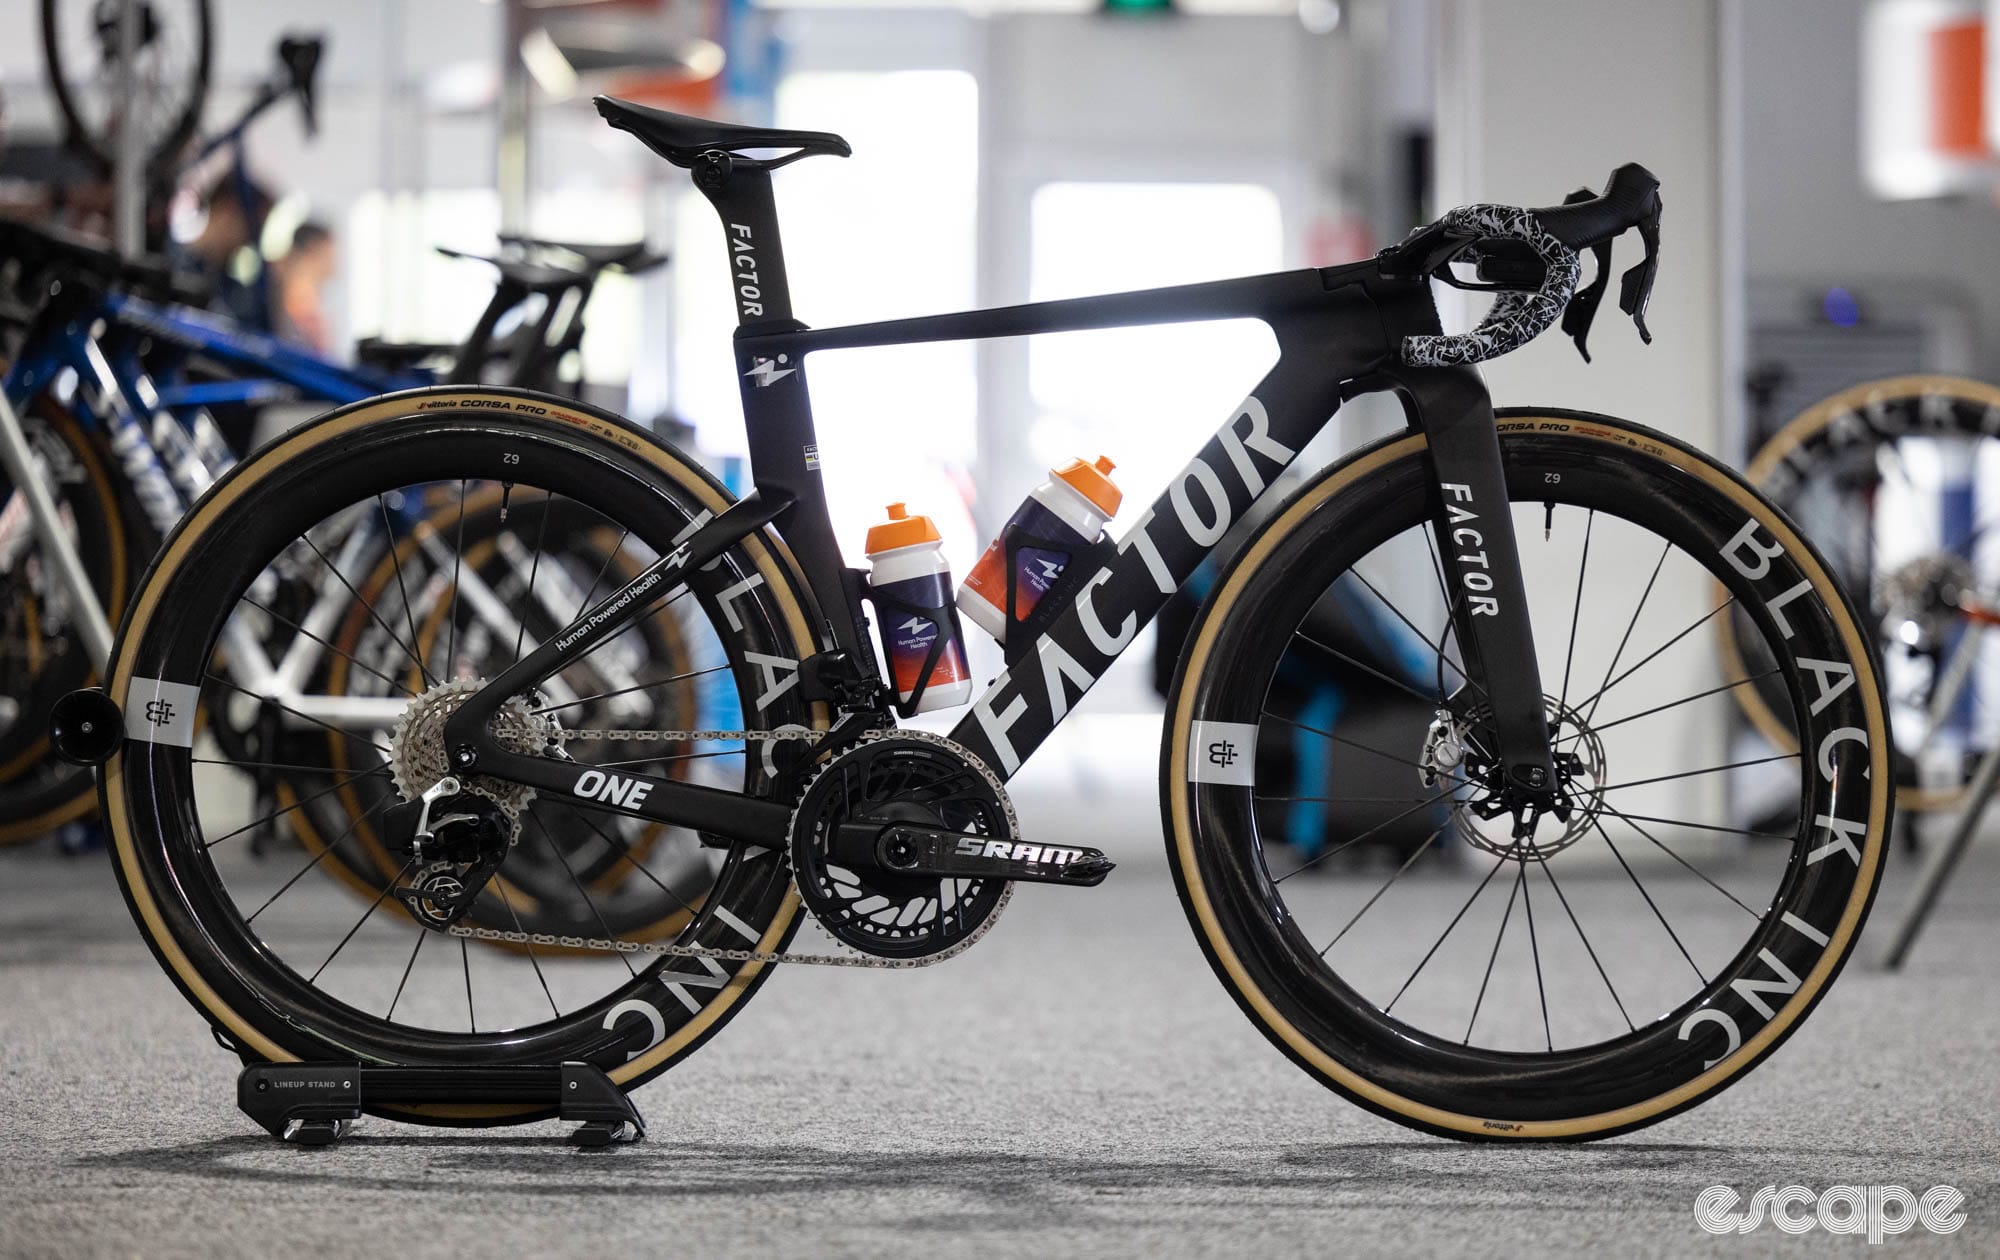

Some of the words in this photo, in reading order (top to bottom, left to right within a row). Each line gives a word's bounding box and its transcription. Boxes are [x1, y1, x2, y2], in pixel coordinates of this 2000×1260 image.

[730, 223, 763, 316] FACTOR
[460, 399, 511, 410] CORSA
[515, 403, 547, 416] PRO
[1496, 422, 1535, 432] ORSA
[1539, 423, 1570, 432] PRO
[503, 452, 520, 465] 62
[1544, 472, 1561, 484] 62
[973, 395, 1297, 778] FACTOR
[1441, 483, 1500, 616] FACTOR
[555, 624, 592, 652] Human
[589, 594, 631, 628] Powered
[628, 572, 662, 599] Health
[1718, 517, 1871, 867] BLACK
[573, 770, 654, 811] ONE
[954, 837, 1085, 864] SRAM
[602, 904, 763, 1062] INC
[1678, 910, 1830, 1071] INC
